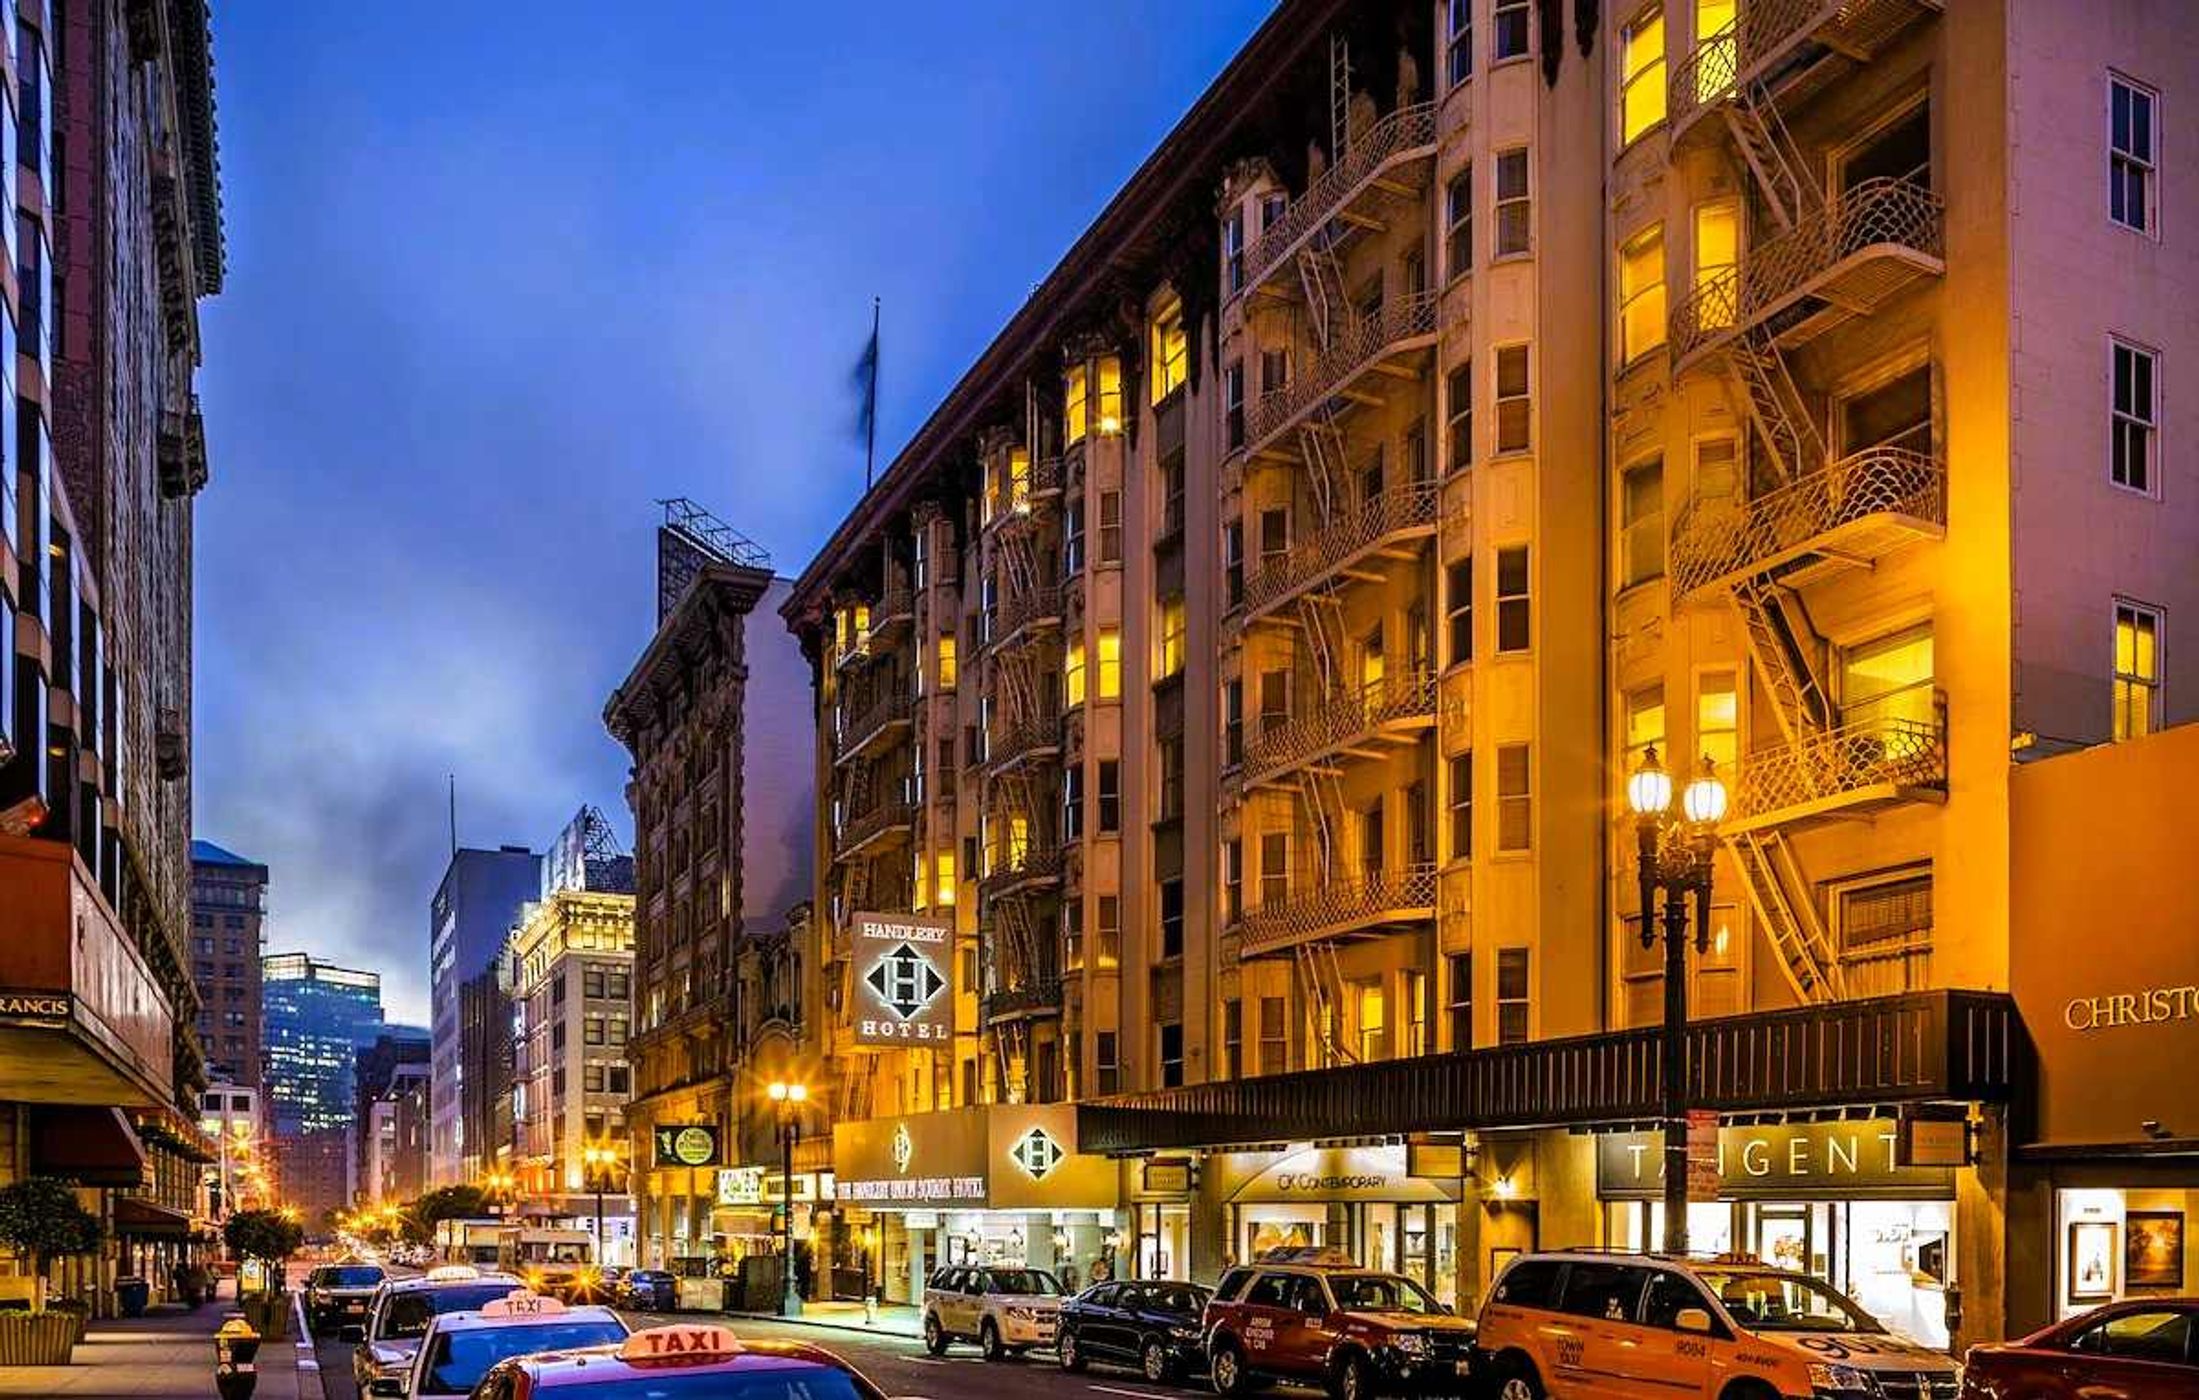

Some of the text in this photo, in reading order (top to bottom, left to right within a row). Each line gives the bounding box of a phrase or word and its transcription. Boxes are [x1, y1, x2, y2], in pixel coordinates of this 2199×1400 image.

[863, 922, 946, 941] HANDLERY
[2065, 985, 2199, 1030] CHRIST
[863, 1020, 947, 1039] HOTEL
[1627, 1133, 1898, 1179] TGENT
[504, 1299, 542, 1314] TAXI
[645, 1331, 720, 1353] TAXI
[1557, 1335, 1584, 1352] TOWN
